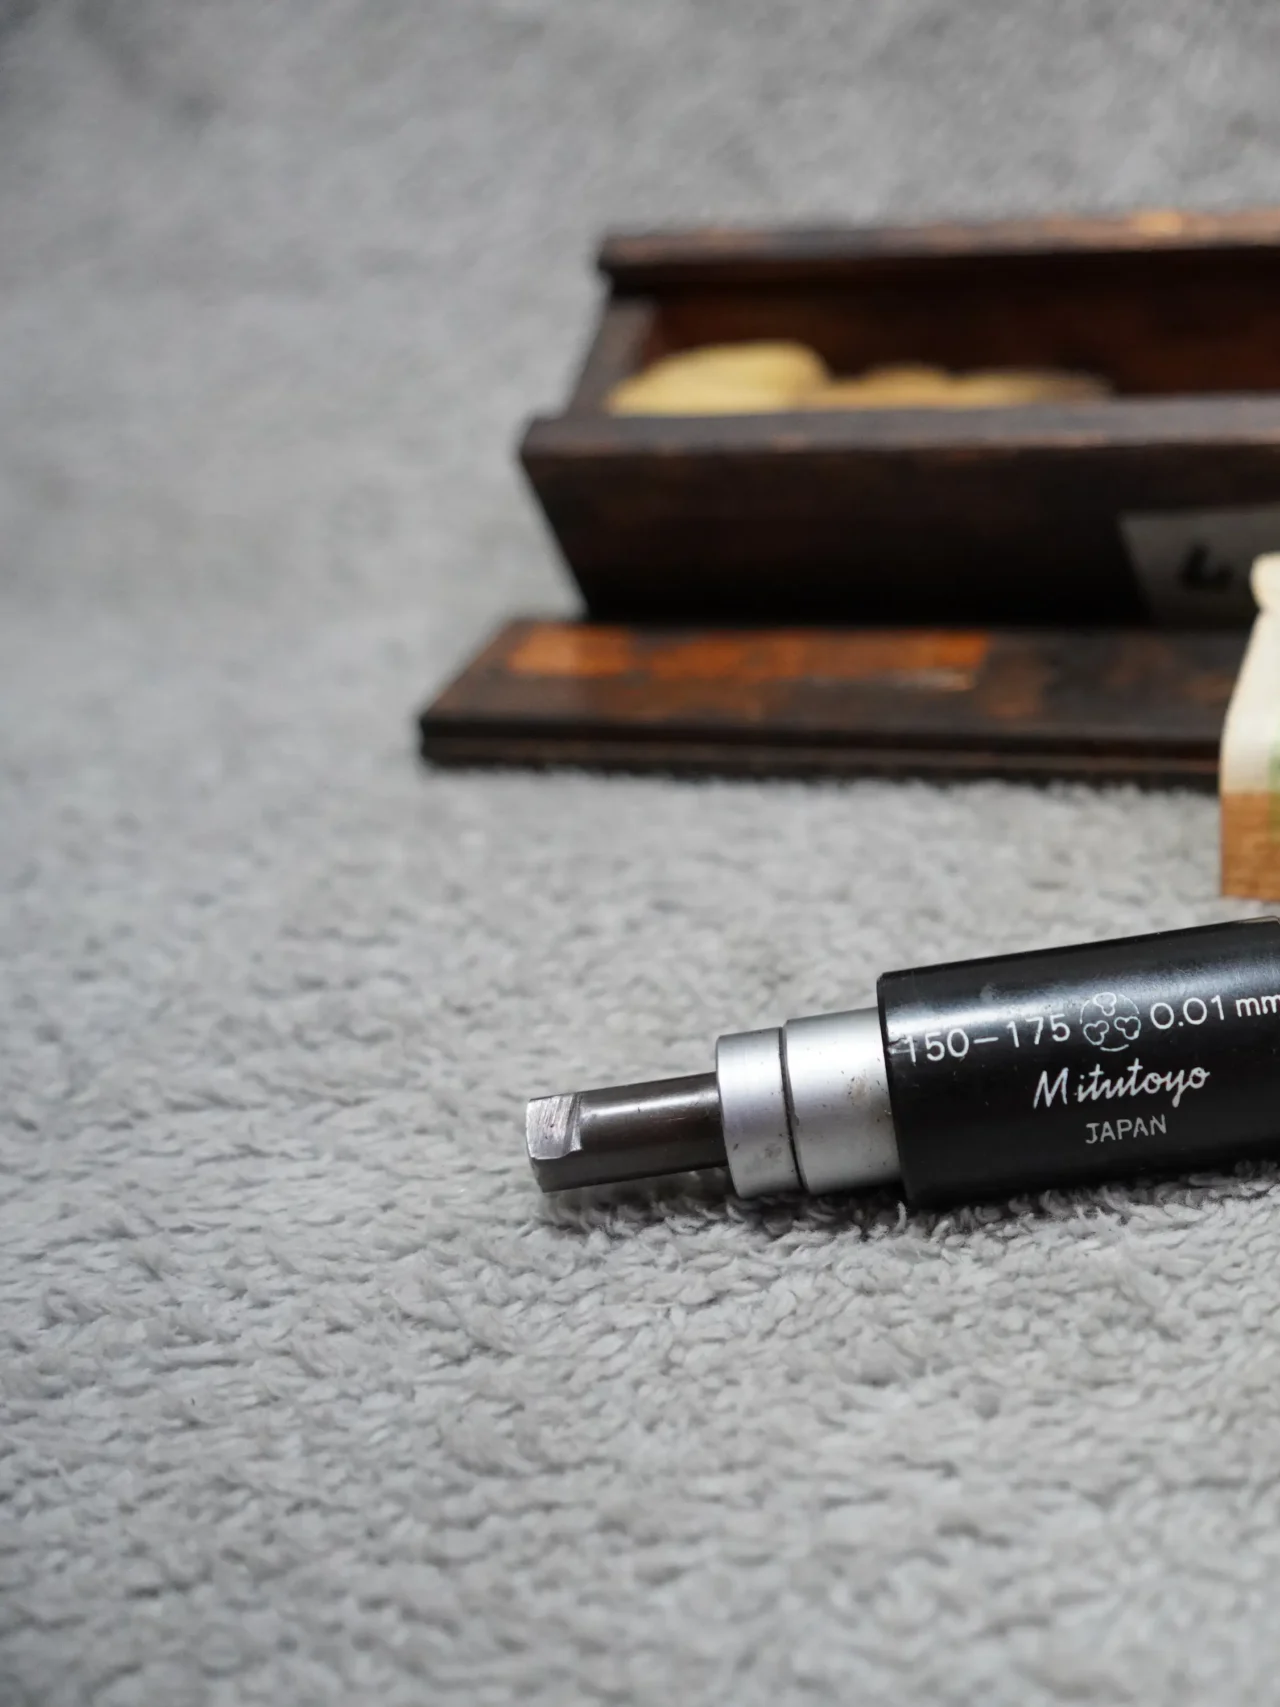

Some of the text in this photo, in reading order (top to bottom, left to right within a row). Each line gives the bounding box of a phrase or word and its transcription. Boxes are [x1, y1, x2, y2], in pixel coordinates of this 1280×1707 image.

[902, 1014, 1071, 1064] 150-175
[1150, 995, 1226, 1031] 0.01
[1033, 1057, 1211, 1110] Mitutoyo
[1084, 1114, 1168, 1145] JAPAN
